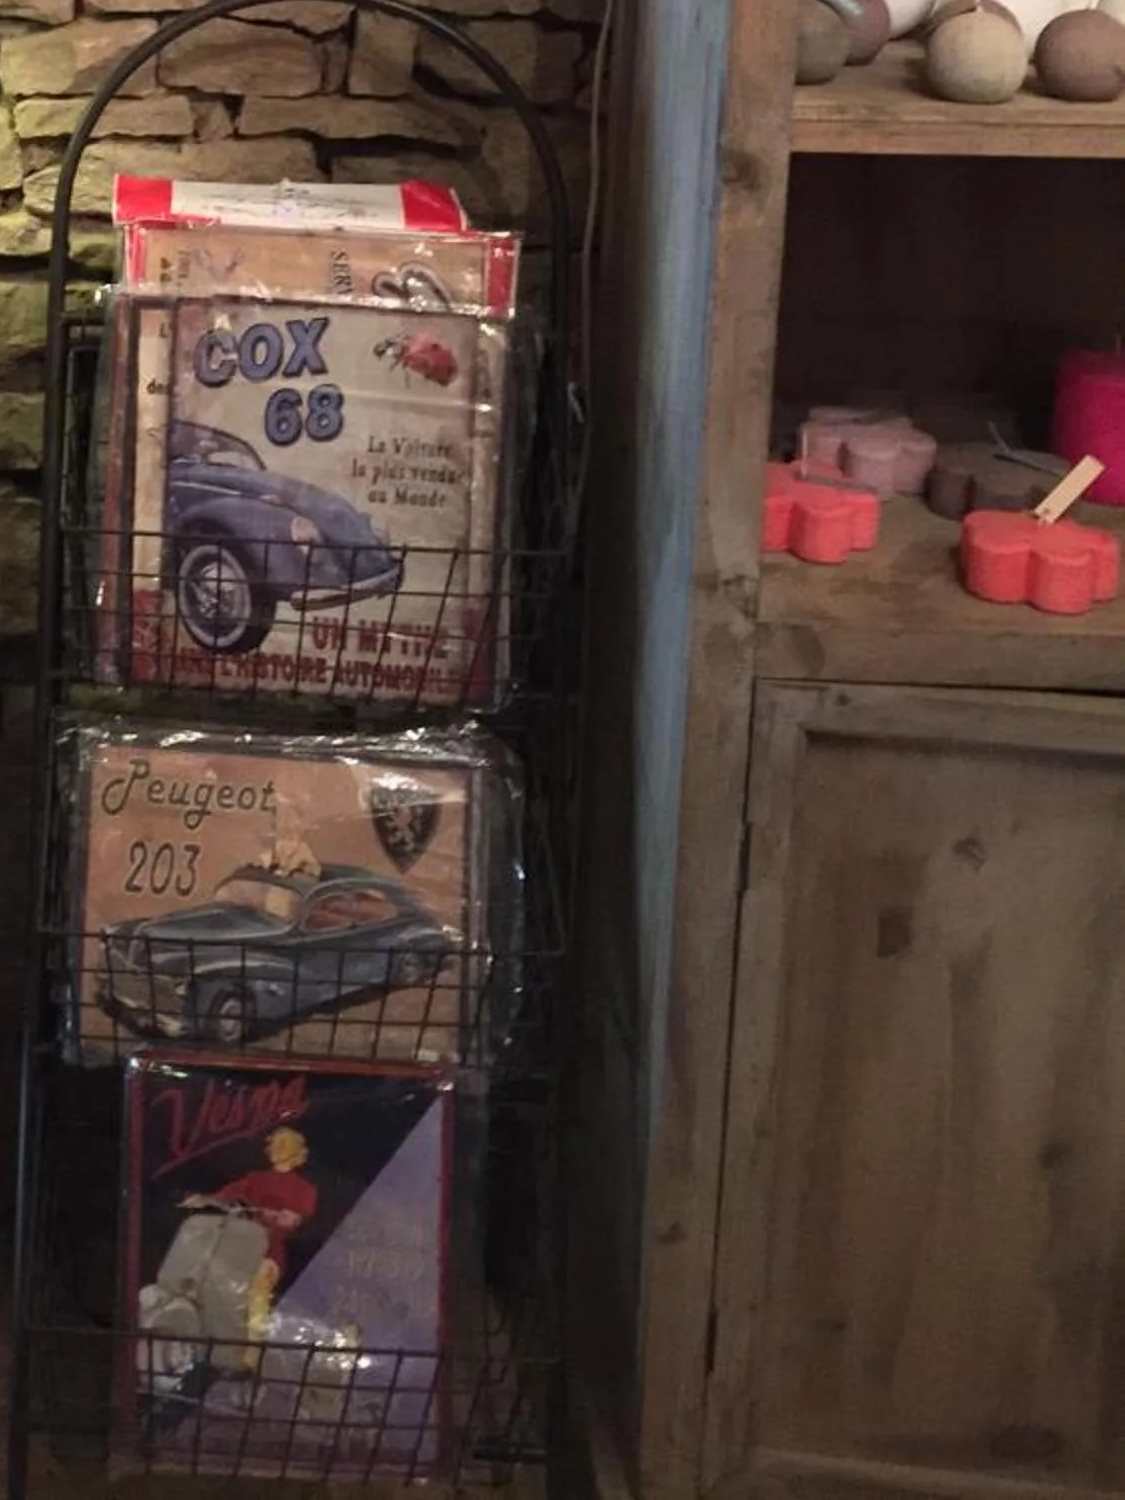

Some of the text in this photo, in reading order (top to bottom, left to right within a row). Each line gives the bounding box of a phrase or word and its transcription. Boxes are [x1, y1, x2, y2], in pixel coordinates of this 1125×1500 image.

[192, 315, 331, 388] COX
[263, 383, 345, 446] 68
[101, 758, 277, 830] Peugeot
[124, 841, 203, 897] 203
